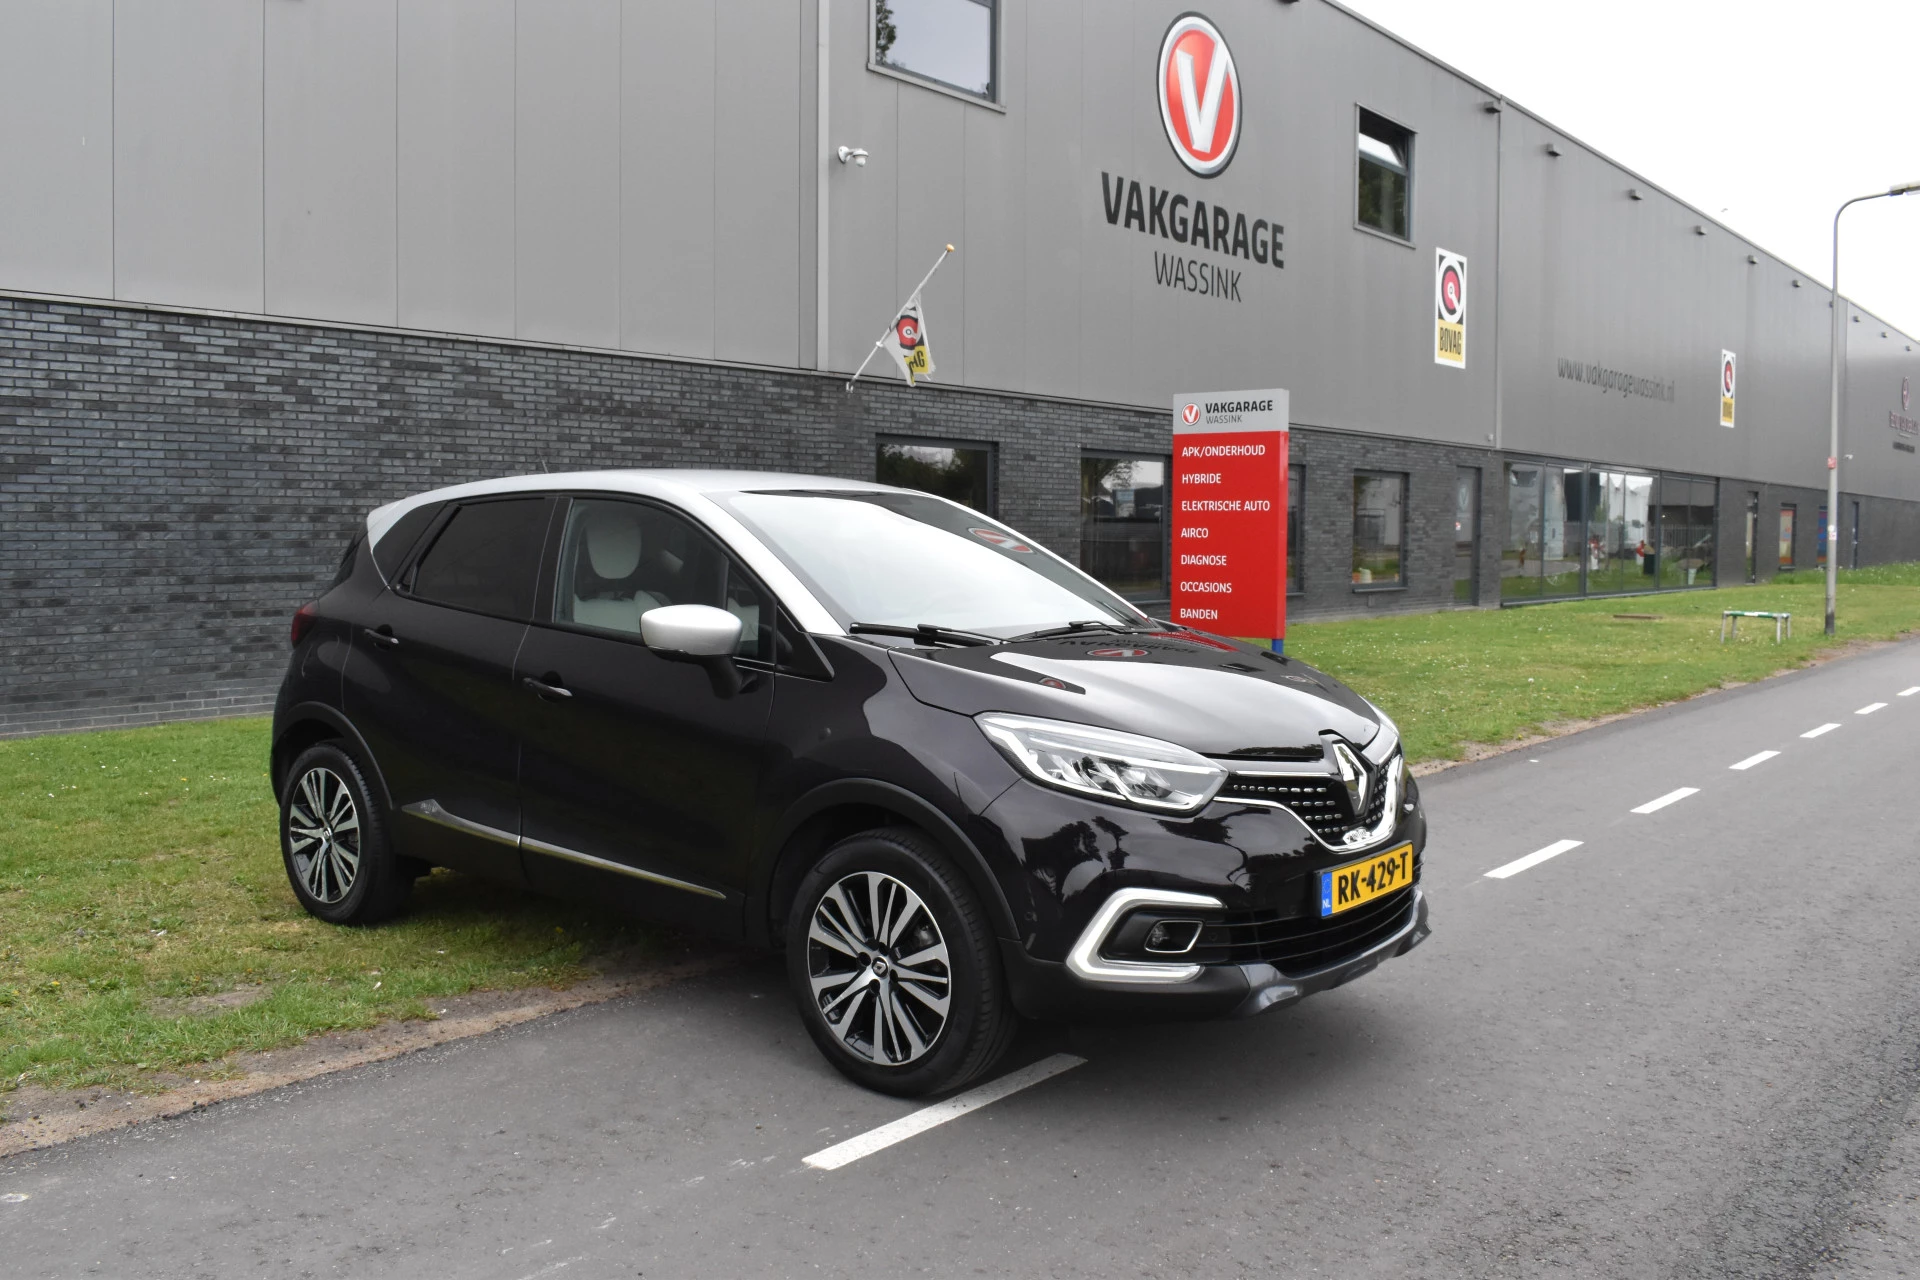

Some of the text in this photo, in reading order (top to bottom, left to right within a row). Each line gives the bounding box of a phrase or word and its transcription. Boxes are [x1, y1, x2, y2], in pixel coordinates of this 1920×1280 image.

[1101, 171, 1284, 269] VAKGARAGE
[1154, 251, 1242, 303] WASSINK
[1440, 327, 1462, 355] BOVAG
[1205, 400, 1273, 413] VAKGARAGE
[1206, 415, 1242, 424] WASSINK
[1182, 445, 1265, 457] APK/ONDERHOUD
[1182, 473, 1221, 484] HYBRIDE
[1181, 500, 1270, 511] ELEKTRISCHE AUTO
[1181, 527, 1209, 538] AIRCO
[1181, 555, 1227, 566] DIAGNOSE
[1180, 582, 1232, 593] OCCASIONS
[1180, 608, 1218, 619] BANDEN
[1338, 852, 1408, 905] RK-429-T
[1322, 899, 1331, 908] NL
